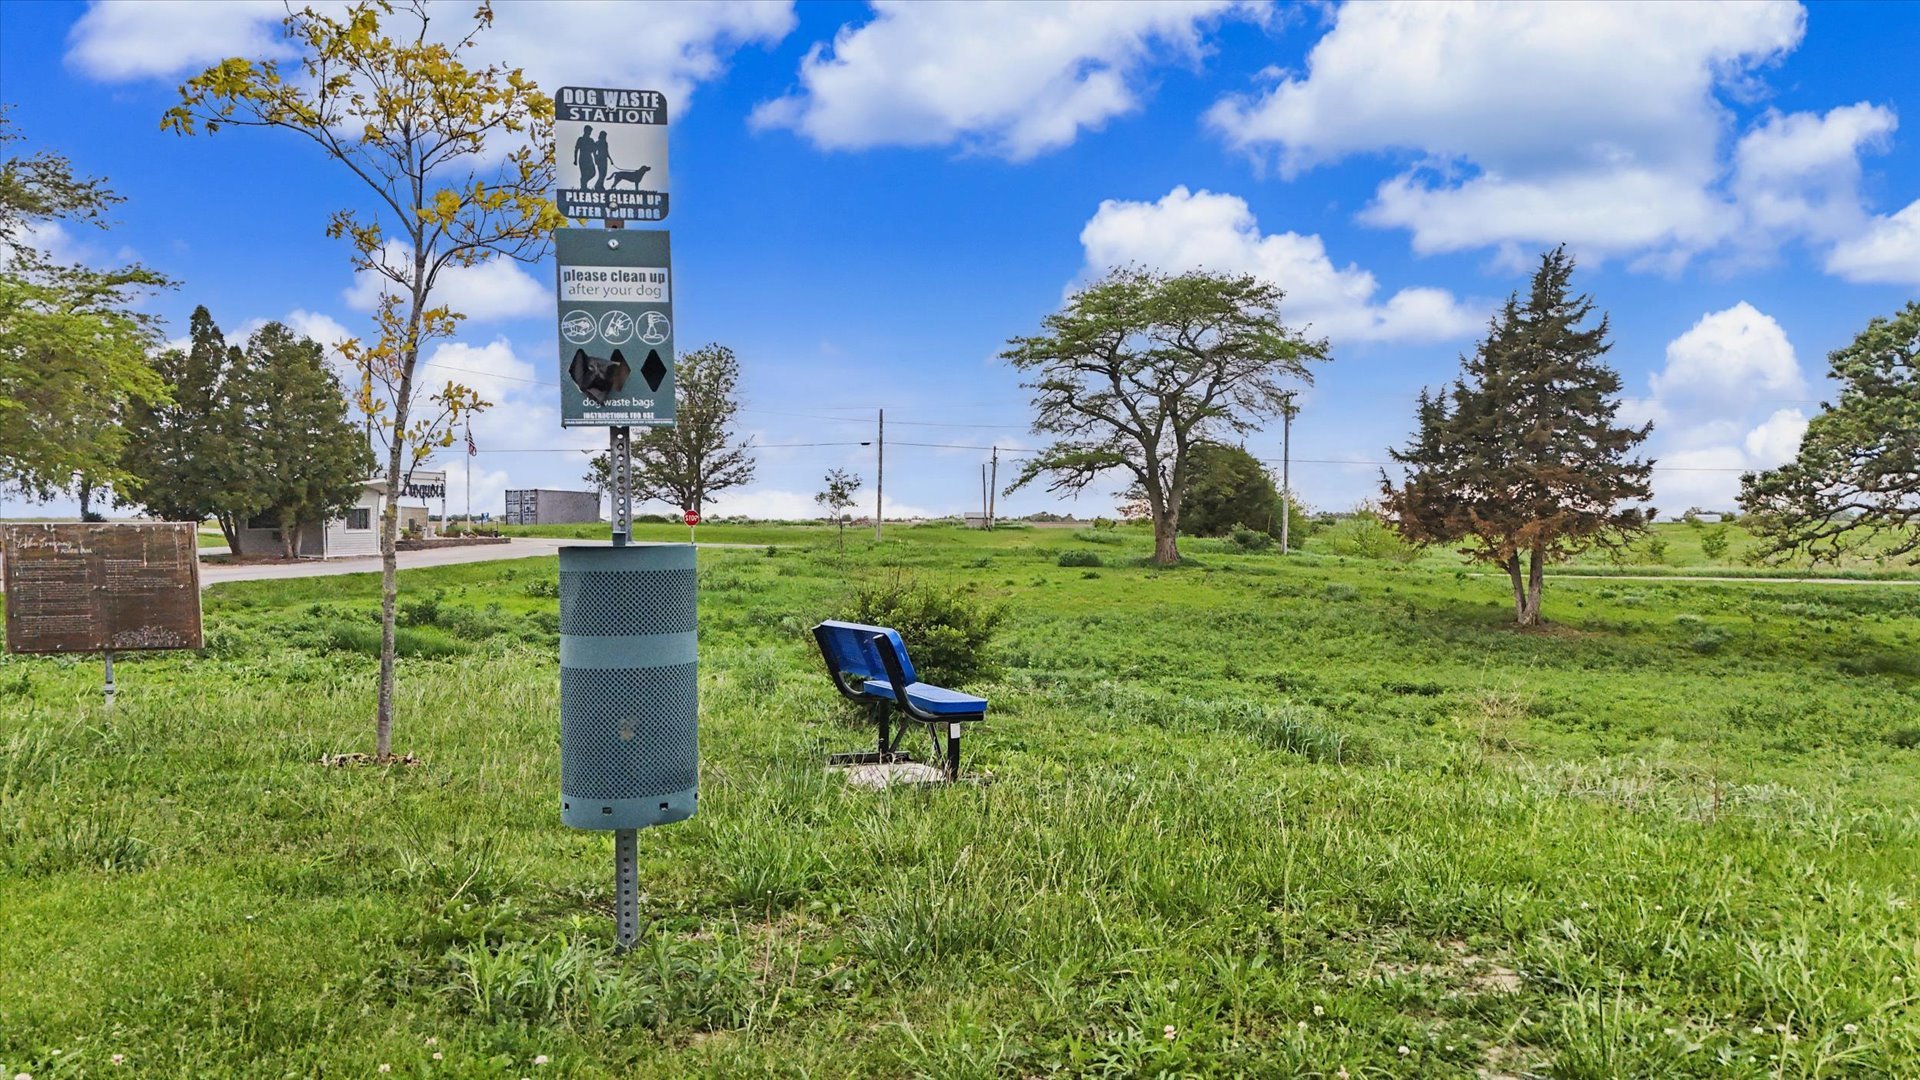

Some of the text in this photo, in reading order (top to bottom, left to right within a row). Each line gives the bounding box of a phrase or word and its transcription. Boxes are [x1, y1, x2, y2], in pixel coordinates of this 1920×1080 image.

[563, 89, 659, 108] DOG WASTE
[569, 107, 655, 123] STATION
[565, 191, 662, 206] PLEASE CLEAN UP
[568, 206, 661, 219] AFTER YOUR DOG
[563, 269, 666, 284] please clean up
[568, 283, 662, 298] after your dog
[603, 399, 631, 407] waste
[632, 397, 655, 409] bags
[685, 514, 699, 522] STOP
